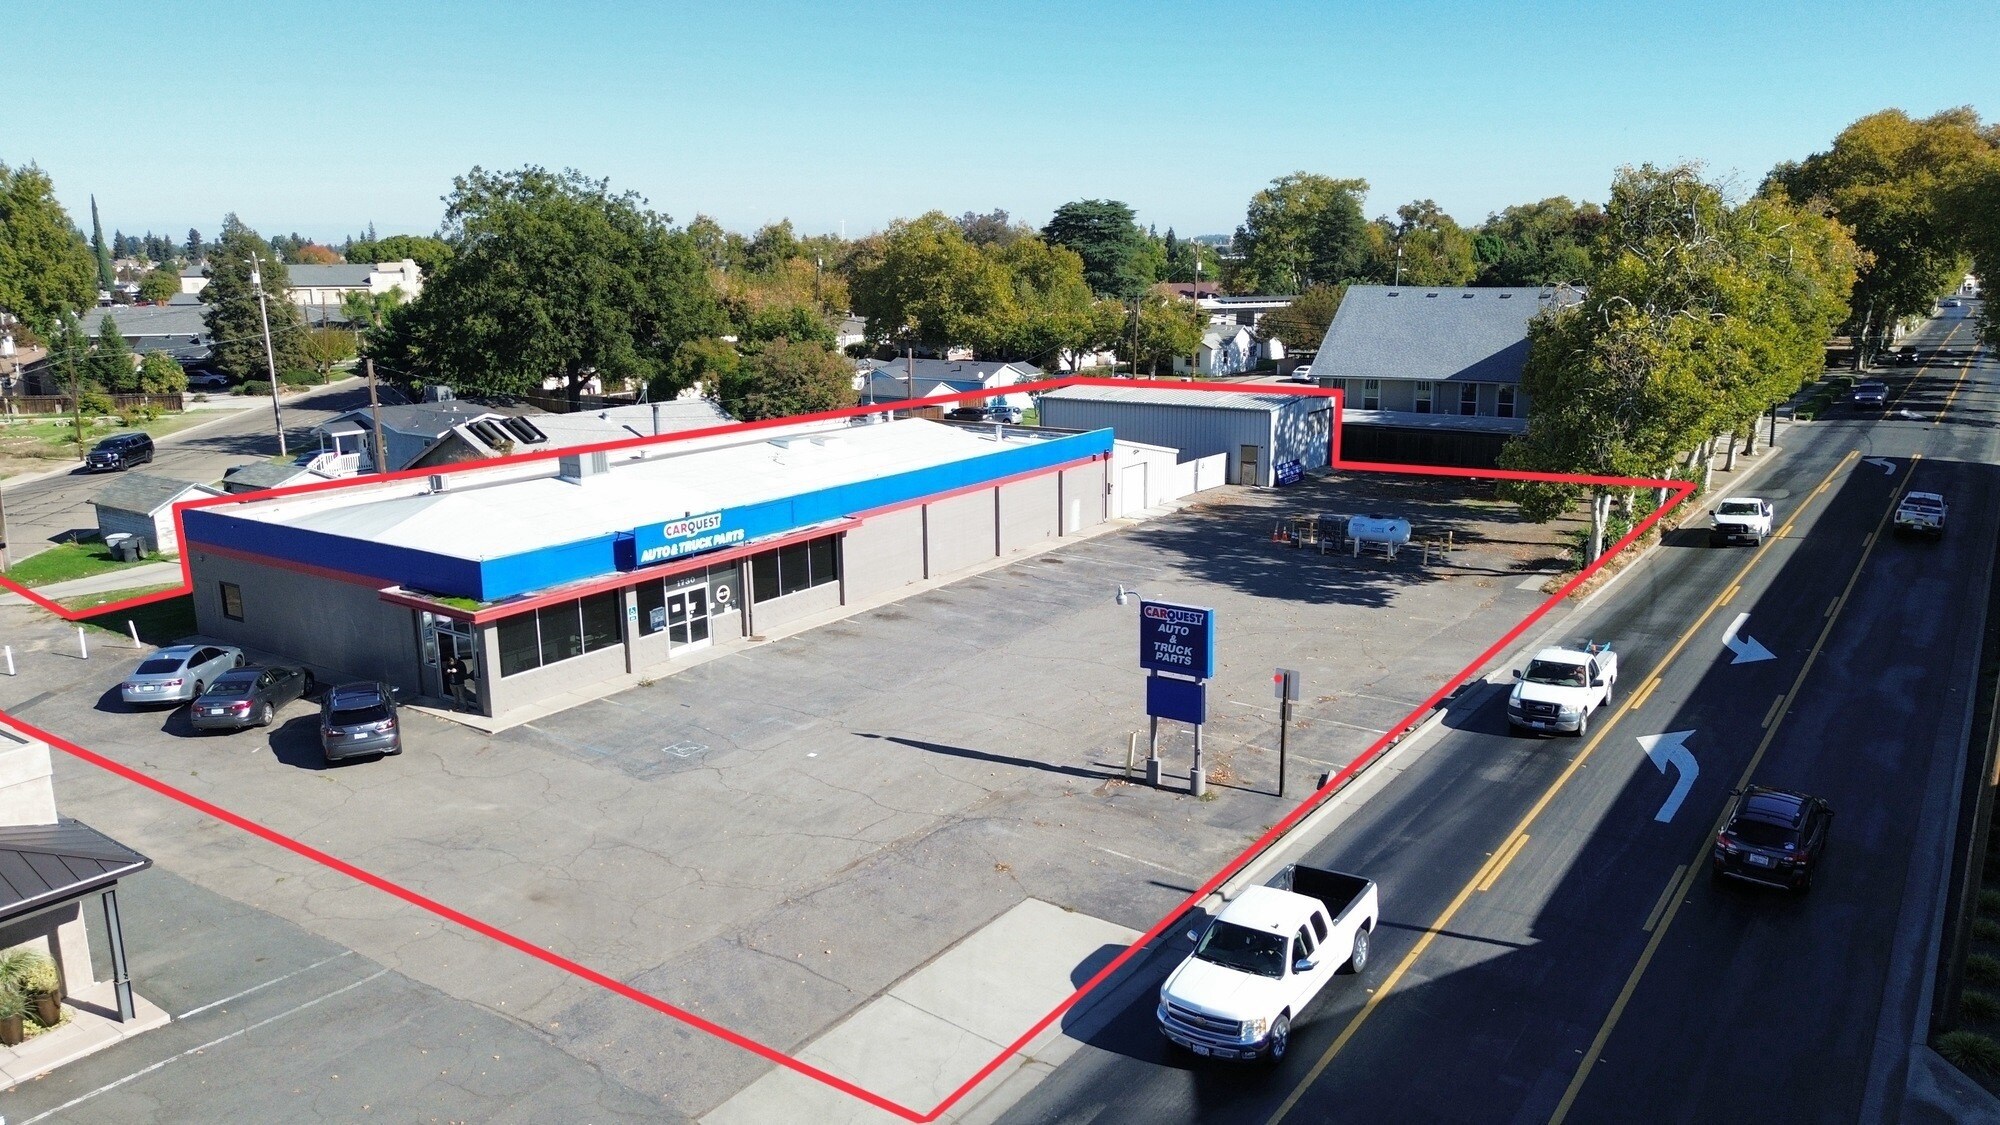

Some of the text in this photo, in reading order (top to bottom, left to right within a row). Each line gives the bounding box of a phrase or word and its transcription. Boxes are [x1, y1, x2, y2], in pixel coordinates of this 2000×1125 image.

[666, 516, 720, 536] CARQUEST
[679, 536, 713, 553] TRUCK
[713, 528, 744, 546] PARTS
[677, 576, 695, 587] 1730
[1145, 606, 1203, 624] CARQUEST
[1158, 623, 1189, 636] AUTO
[1169, 634, 1177, 644] &
[1154, 641, 1193, 656] TRUCK
[1155, 651, 1192, 666] PARTS
